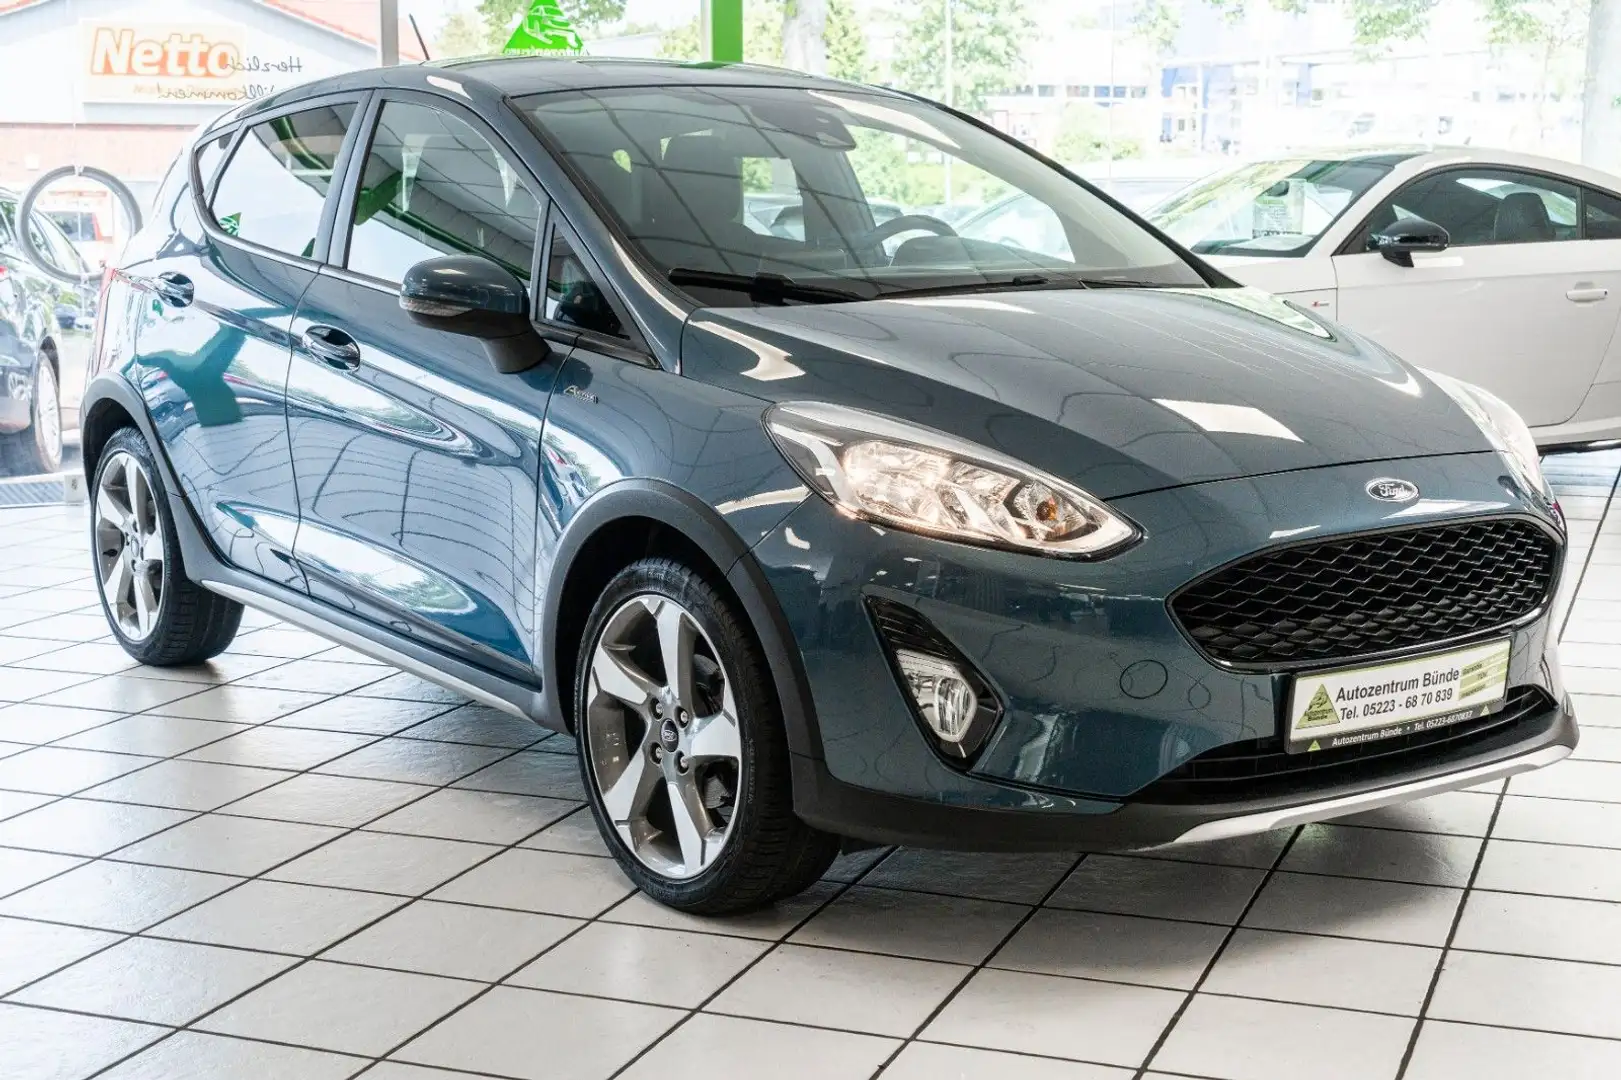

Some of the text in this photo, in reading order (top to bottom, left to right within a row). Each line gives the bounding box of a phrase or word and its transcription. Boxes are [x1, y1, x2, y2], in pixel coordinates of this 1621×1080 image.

[91, 27, 239, 78] Netto
[1335, 678, 1419, 702] Autozentrum
[1422, 668, 1460, 687] Bünde
[1340, 706, 1359, 720] Tel.
[1363, 699, 1396, 716] 05223
[1405, 695, 1418, 708] 68
[1421, 692, 1433, 706] 70
[1435, 688, 1453, 703] 839
[1332, 732, 1379, 746] Autozentrum
[1380, 727, 1403, 738] Bünde
